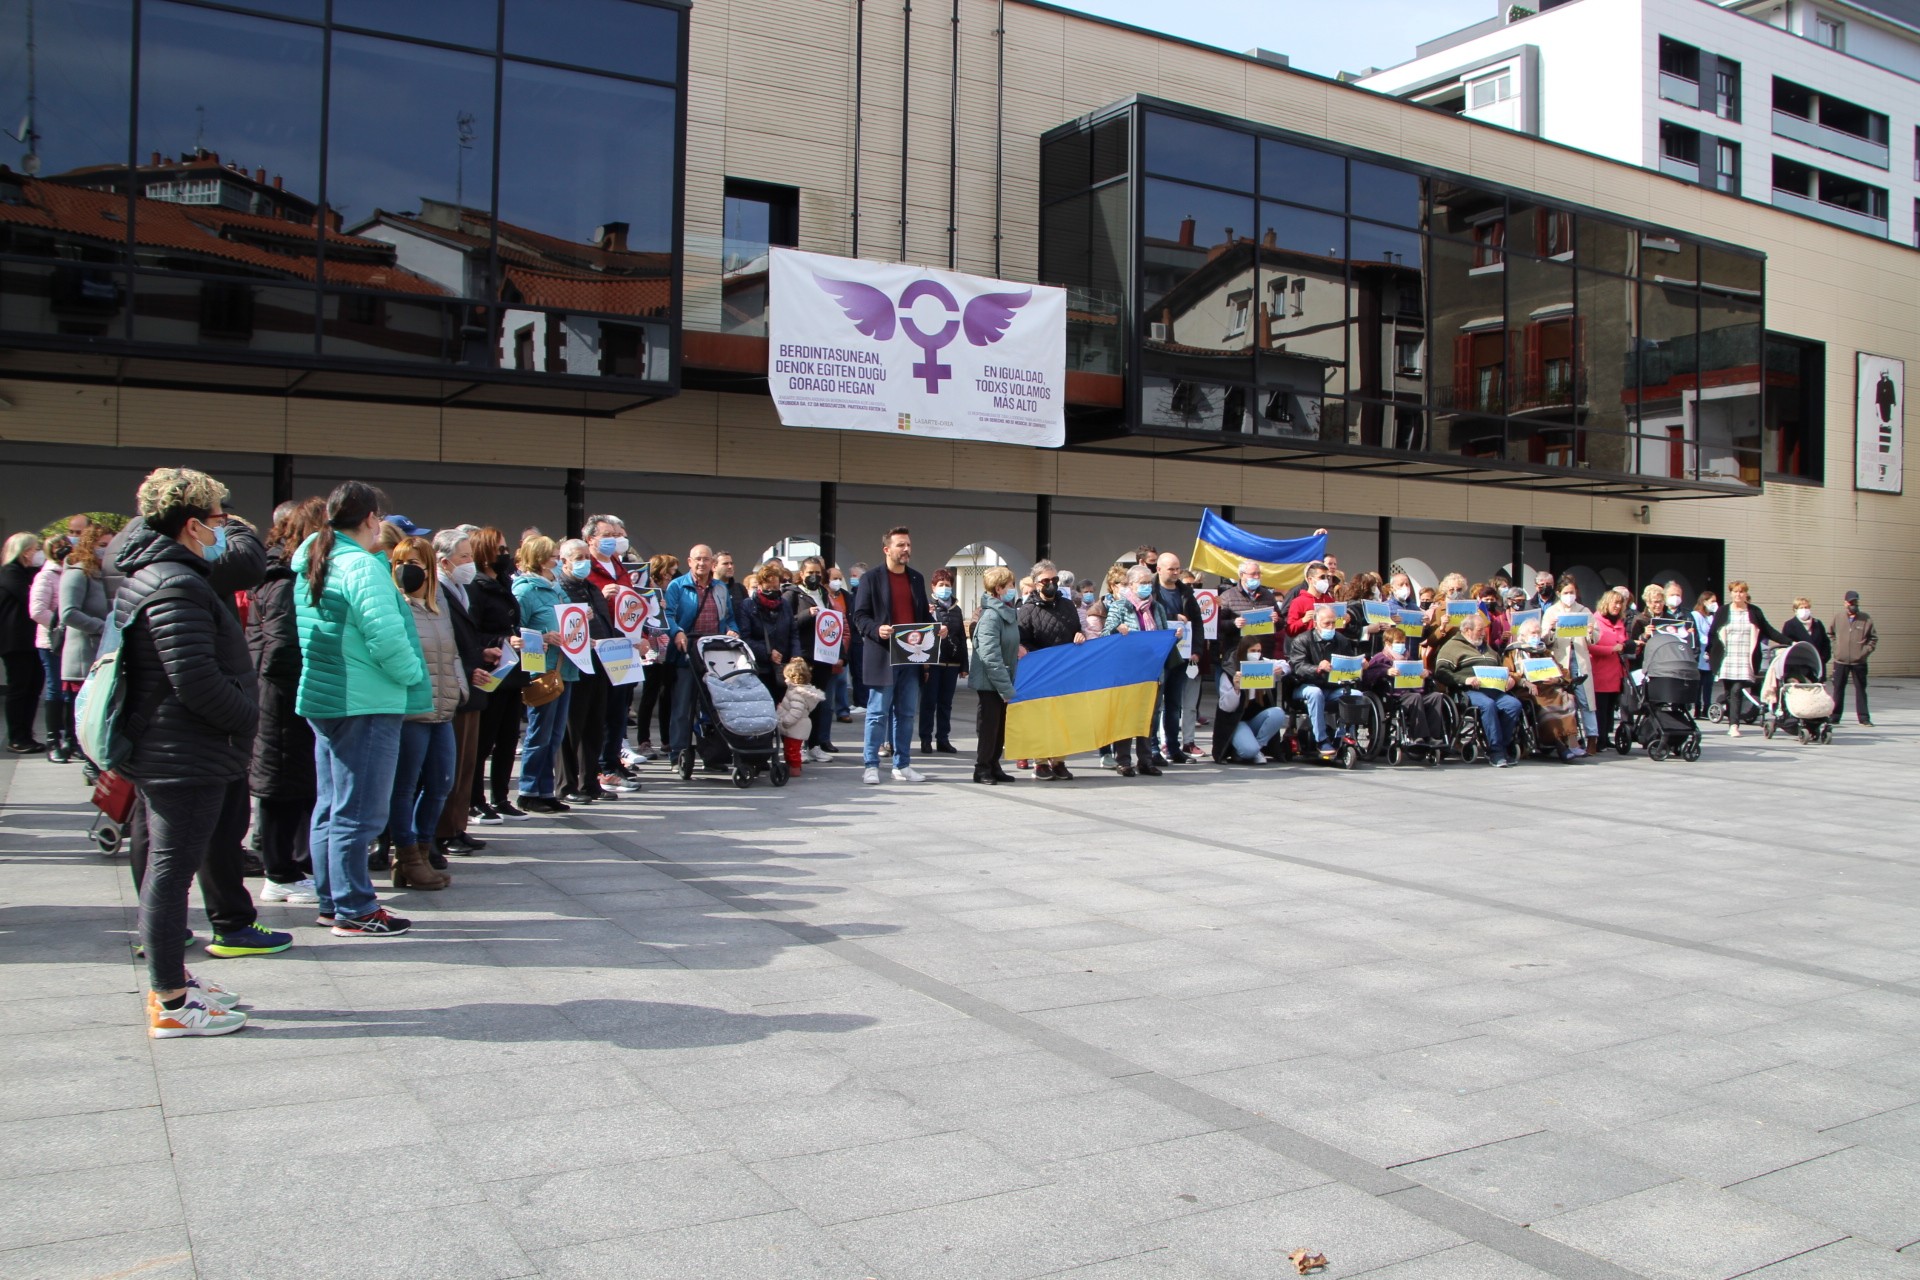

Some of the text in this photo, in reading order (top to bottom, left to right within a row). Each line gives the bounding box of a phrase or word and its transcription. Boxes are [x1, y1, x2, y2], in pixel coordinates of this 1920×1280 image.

[780, 344, 883, 367] BERDINTASUNEAN,
[776, 360, 886, 381] DENOK EGITEN DUGU
[984, 365, 1046, 385] EN IGUALDAD,
[789, 377, 875, 395] GORAGO HEGAN
[975, 379, 1051, 400] TODXS VOLAMOS
[993, 394, 1037, 412] MÁS ALTO
[624, 600, 638, 609] NO
[569, 618, 581, 628] NO
[825, 620, 835, 628] NO
[1250, 619, 1265, 627] PAZ
[1244, 672, 1271, 681] PAKEA
